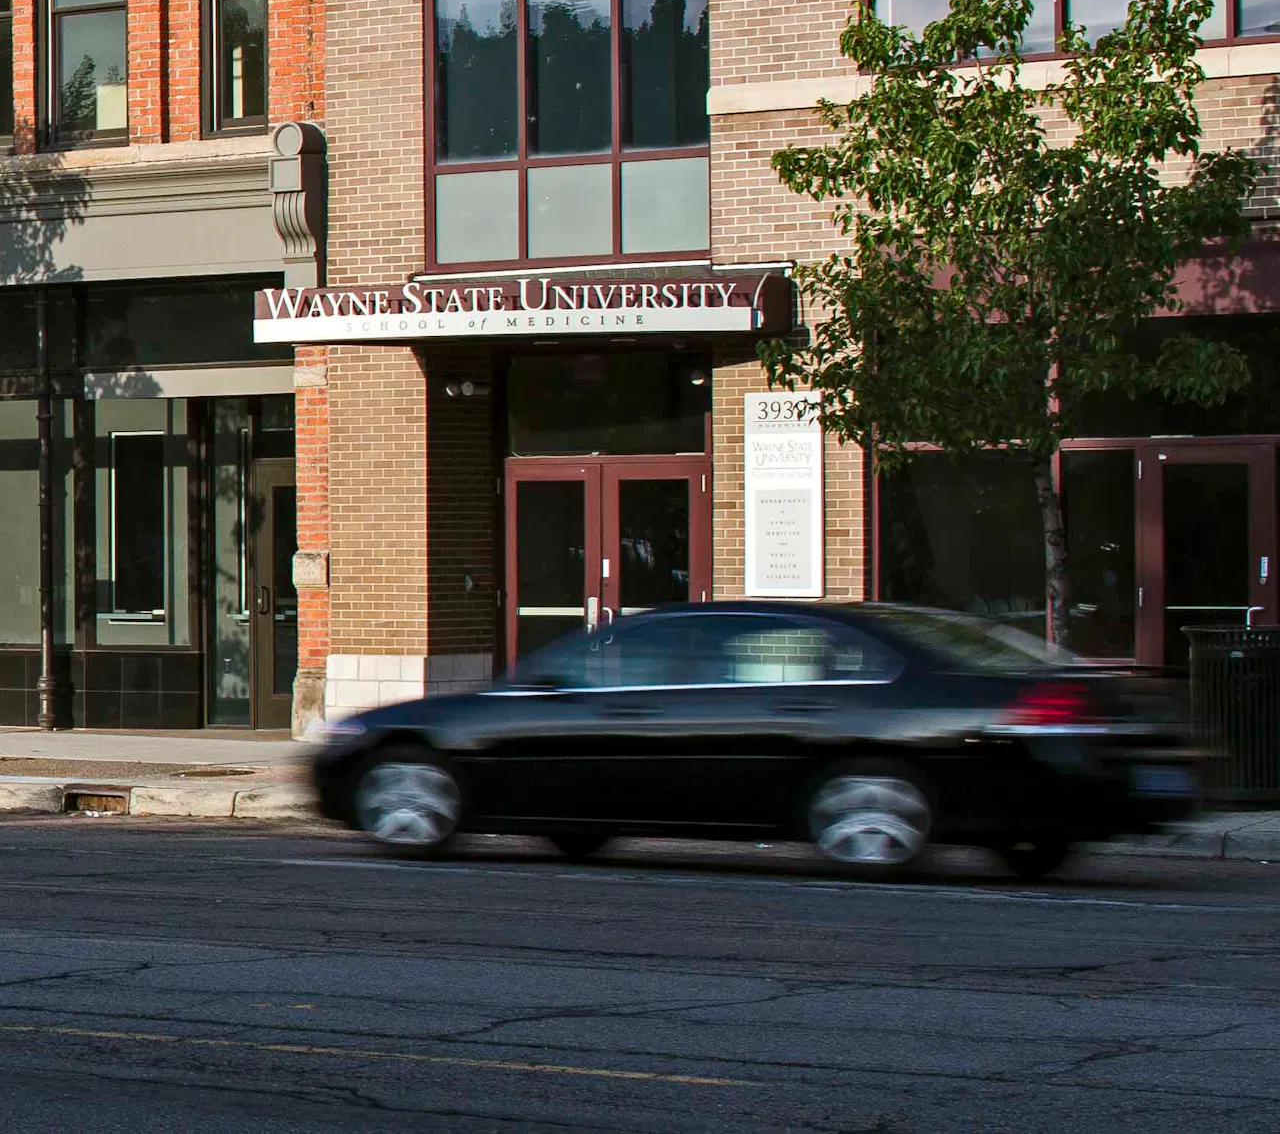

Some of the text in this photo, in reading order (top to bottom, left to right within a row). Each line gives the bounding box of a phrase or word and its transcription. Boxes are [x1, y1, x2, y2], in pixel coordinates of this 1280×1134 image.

[262, 278, 737, 320] WAYNE STATE UNIVERSITY
[346, 314, 644, 332] SCHOOL of MEDICINE
